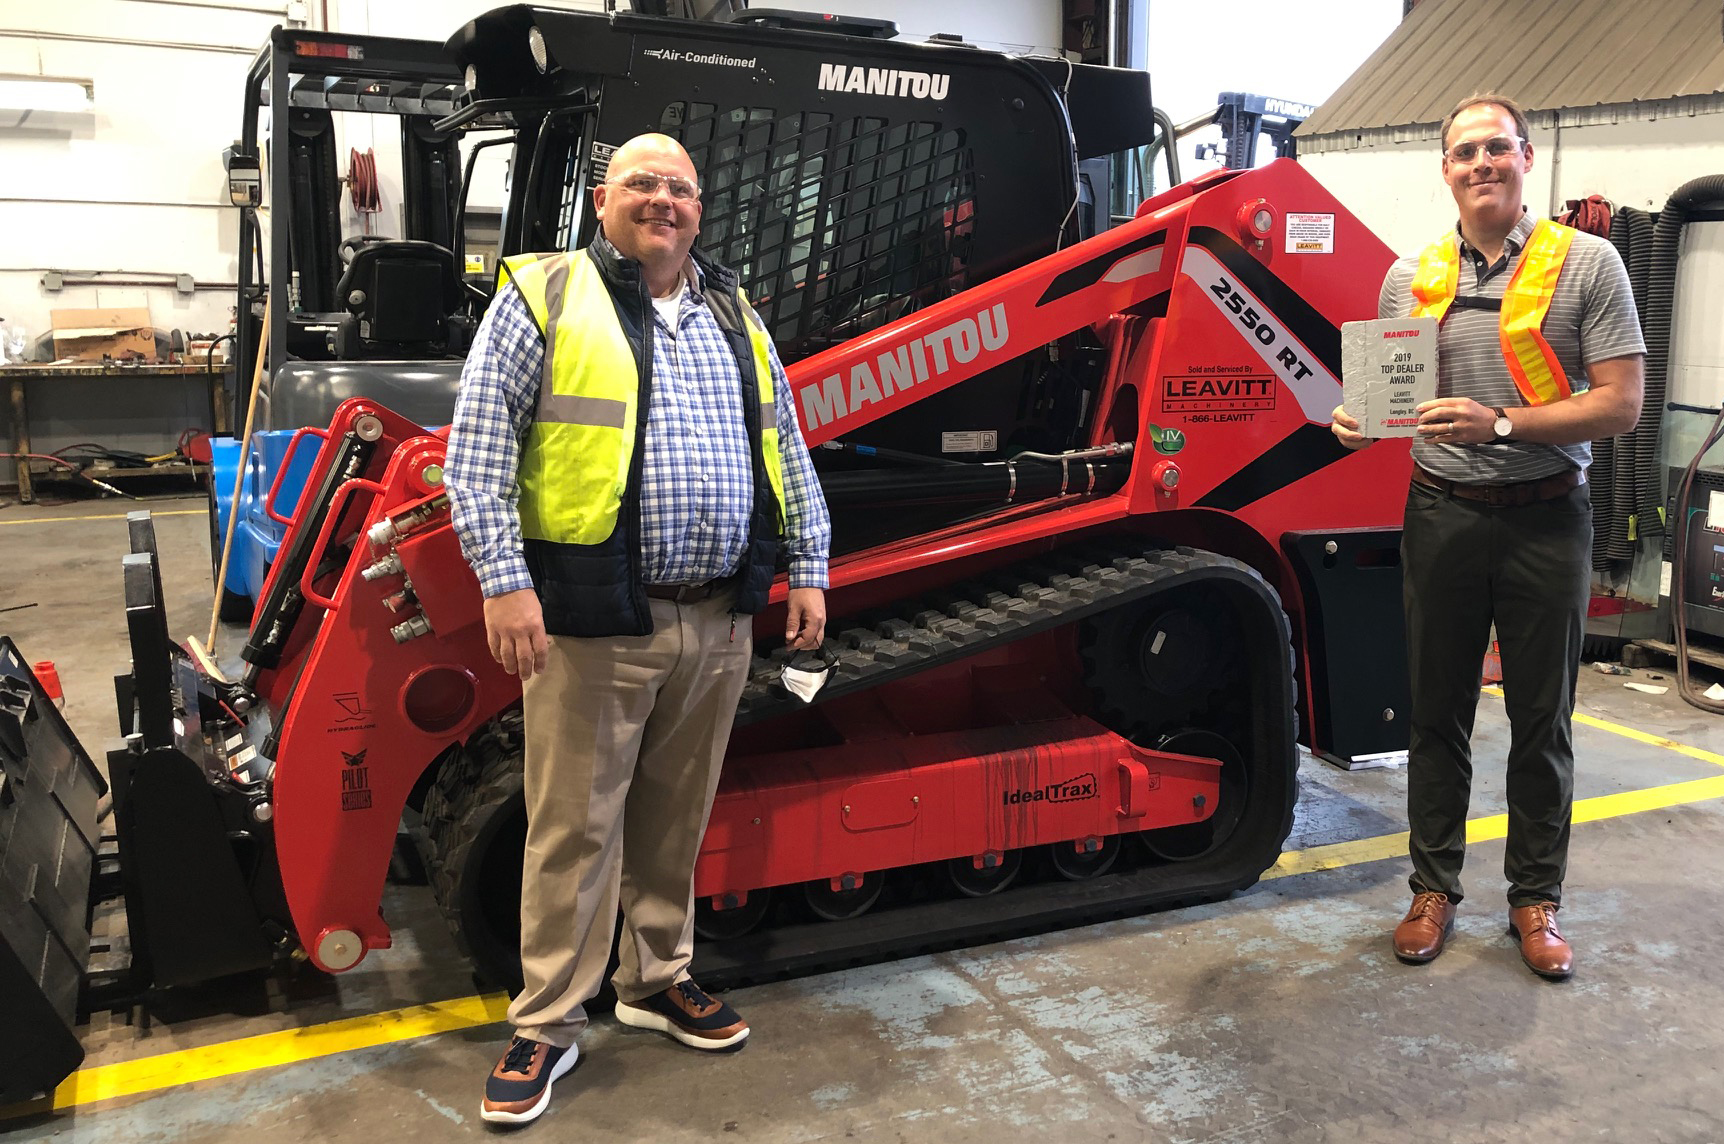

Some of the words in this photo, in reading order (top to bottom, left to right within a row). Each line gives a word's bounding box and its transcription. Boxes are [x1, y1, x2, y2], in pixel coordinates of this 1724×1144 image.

[661, 50, 757, 69] Air-Conditioned
[818, 63, 950, 100] MANITOU
[1210, 276, 1276, 346] 2550
[1276, 345, 1314, 381] RT
[1383, 329, 1420, 339] MANITOU
[1393, 352, 1412, 362] 2019
[800, 302, 1010, 432] MANITOU
[1188, 365, 1203, 374] Sold
[1203, 365, 1216, 373] and
[1216, 365, 1244, 374] Serviced
[1244, 364, 1253, 374] By
[1381, 364, 1395, 374] TOP
[1396, 363, 1425, 373] DEALER
[1389, 375, 1416, 385] AWARD
[1167, 379, 1272, 397] LEAVITT
[1166, 401, 1272, 410] MACHINERY
[1183, 413, 1256, 424] 1-866-LEAVITT
[1387, 417, 1420, 425] MANITOU
[342, 767, 369, 791] PILOT
[1003, 782, 1093, 806] IdealTrax
